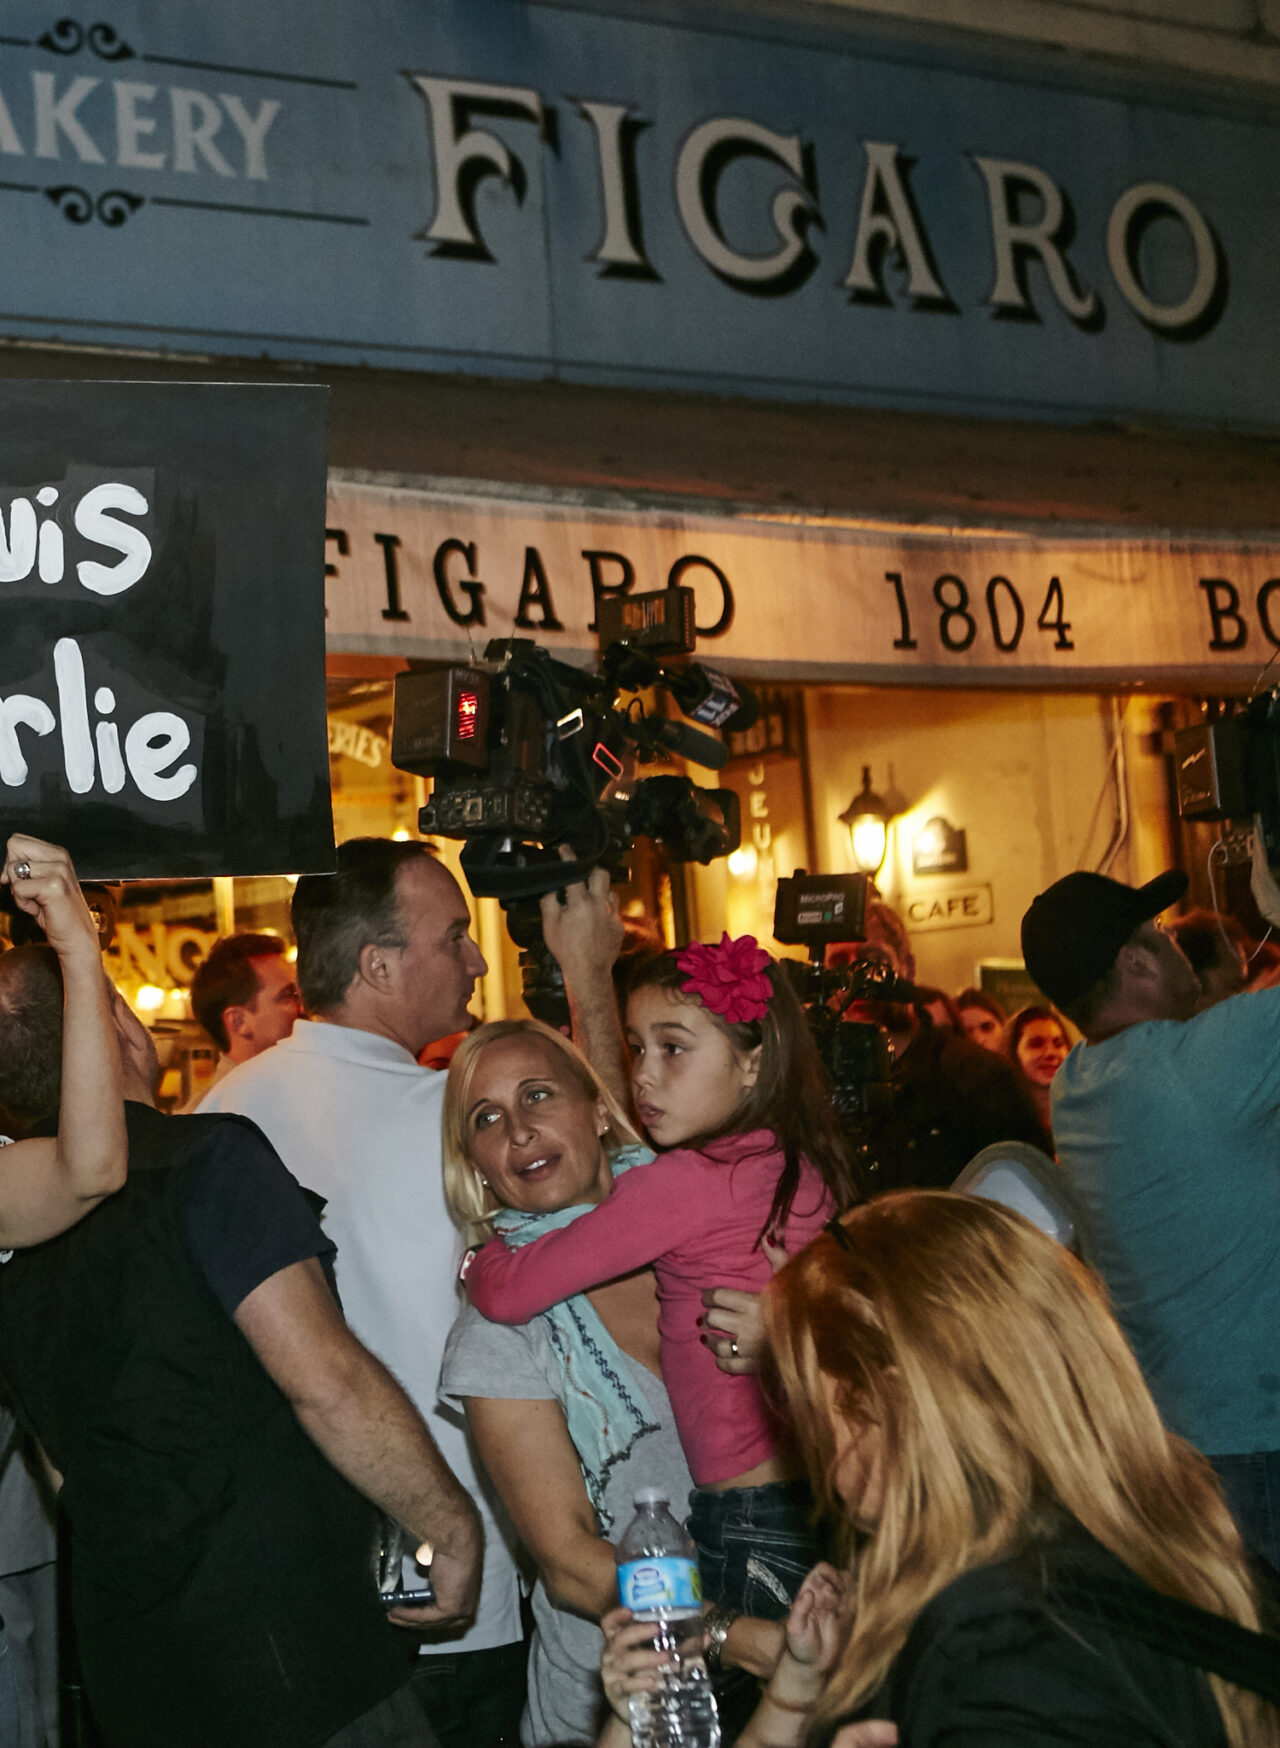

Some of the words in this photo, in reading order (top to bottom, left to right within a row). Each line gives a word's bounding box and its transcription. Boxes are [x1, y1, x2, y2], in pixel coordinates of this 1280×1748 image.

[402, 69, 1228, 341] FIGARO
[884, 572, 1075, 653] 1804
[908, 895, 980, 922] CAFE
